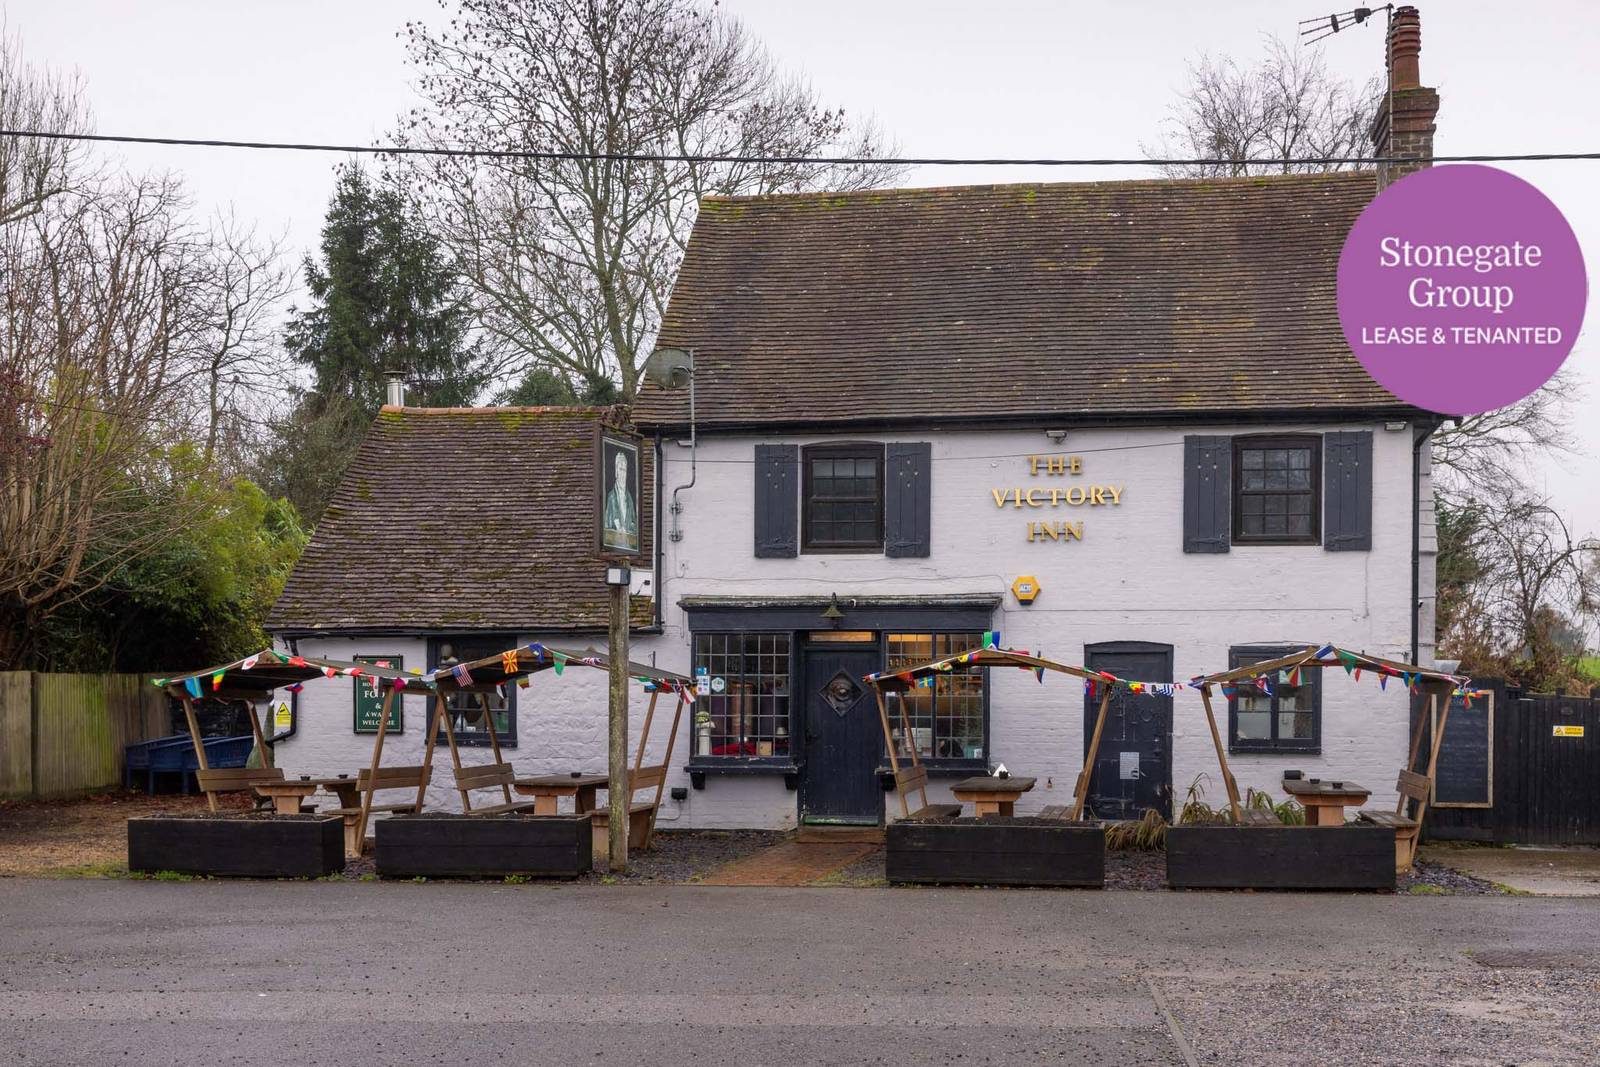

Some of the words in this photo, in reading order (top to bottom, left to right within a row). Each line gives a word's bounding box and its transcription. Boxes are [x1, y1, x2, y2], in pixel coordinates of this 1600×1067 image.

[1028, 455, 1082, 475] THE
[992, 485, 1122, 508] VICTORY
[1027, 521, 1083, 542] INN
